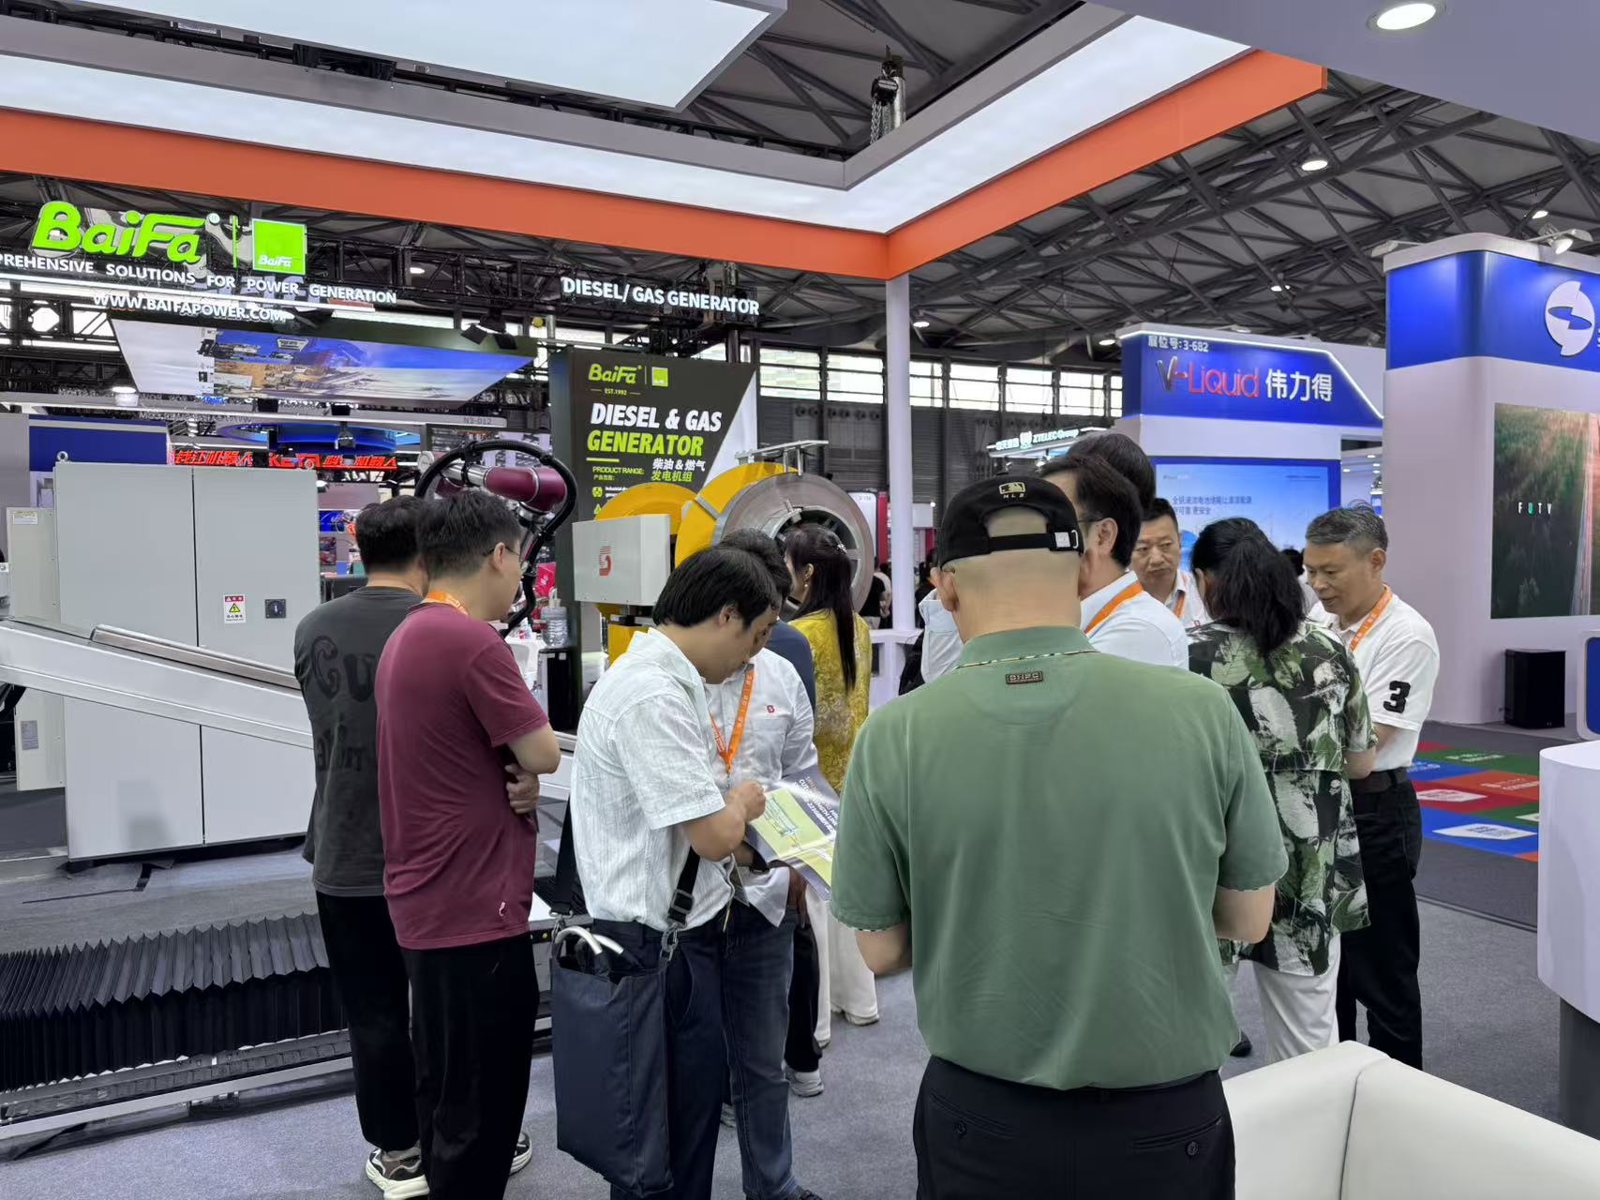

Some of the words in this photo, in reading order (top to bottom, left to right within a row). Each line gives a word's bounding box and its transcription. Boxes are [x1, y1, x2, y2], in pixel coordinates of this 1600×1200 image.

[31, 200, 206, 264] BaiFa
[105, 263, 196, 285] SOLUTIONS
[206, 274, 236, 289] FOR
[247, 279, 300, 295] POWER
[309, 283, 397, 304] GENERATION
[562, 277, 630, 302] DIESEL/
[633, 286, 665, 305] GAS
[668, 290, 760, 316] GENERATOR
[94, 293, 286, 323] WWW.BAIFAPOWER.COM
[588, 363, 637, 384] BaiFa
[1265, 368, 1333, 402] 伟力得
[590, 402, 660, 428] DIESEL
[664, 408, 681, 429] &
[685, 409, 722, 432] GAS
[586, 429, 704, 457] GENERATOR
[651, 471, 693, 482] 发电机组
[652, 458, 674, 470] 柴油
[675, 460, 684, 470] &
[685, 460, 706, 472] 燃气
[1383, 680, 1411, 714] 3
